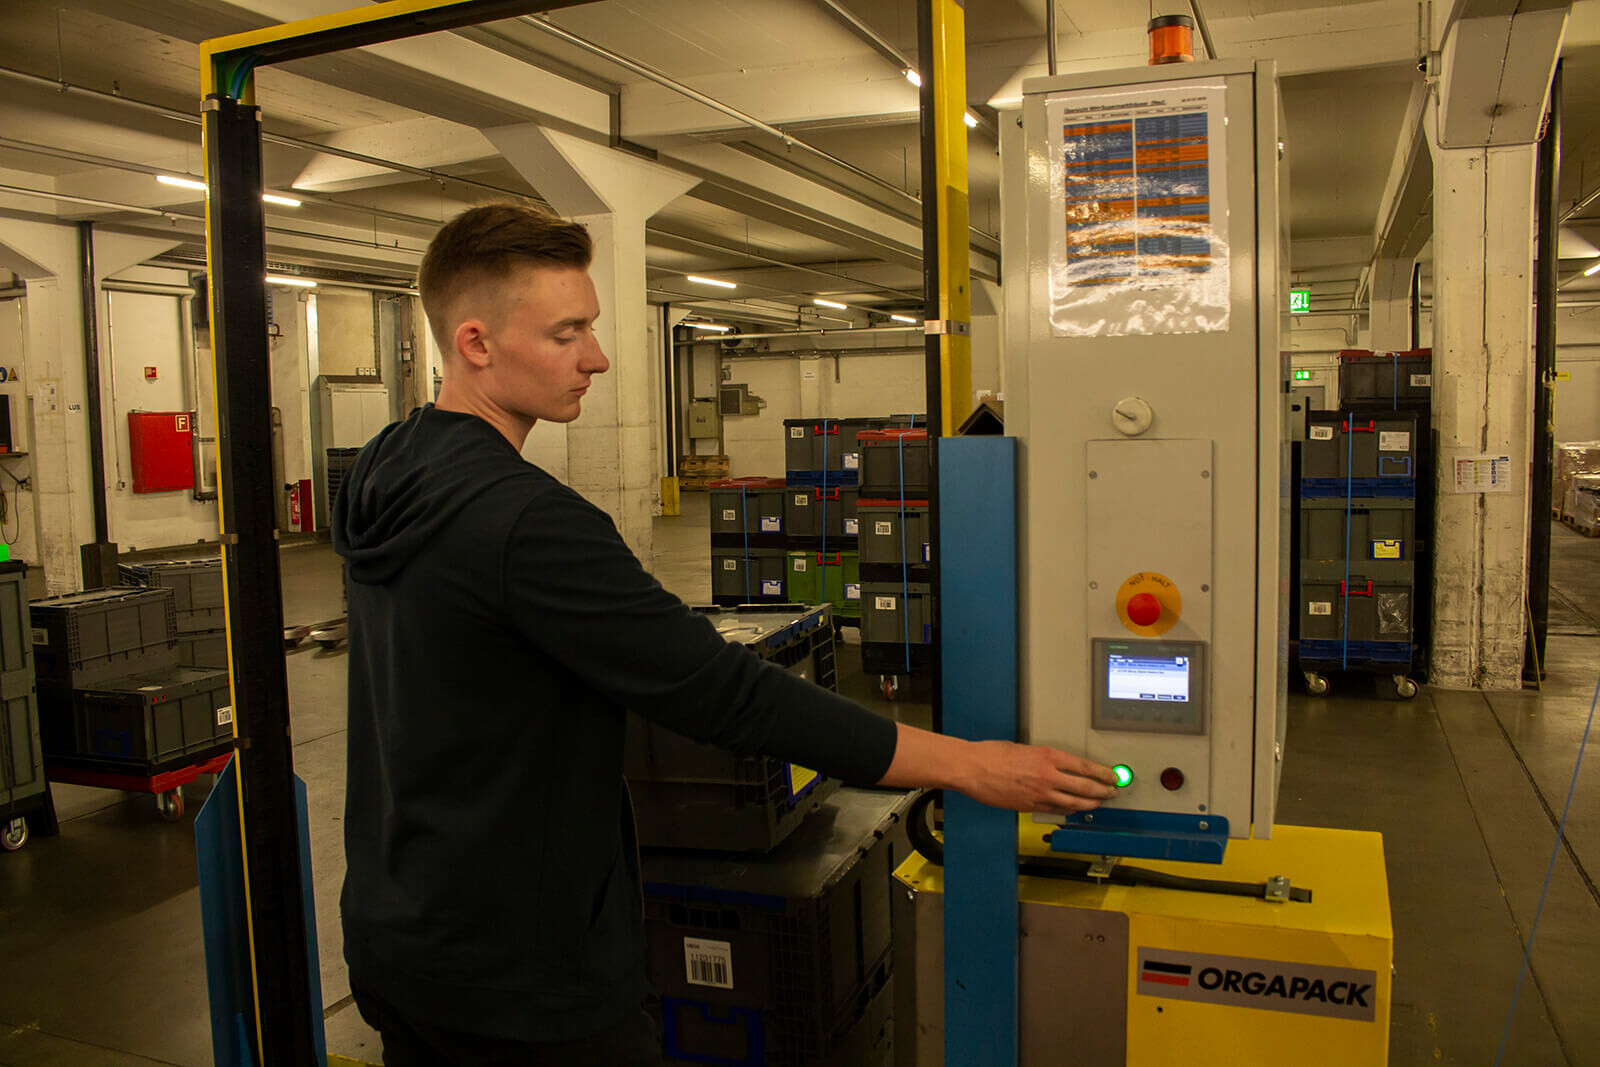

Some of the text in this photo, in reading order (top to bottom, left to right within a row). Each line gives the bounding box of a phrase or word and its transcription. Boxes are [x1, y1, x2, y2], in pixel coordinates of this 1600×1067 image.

[178, 417, 186, 429] F
[1129, 572, 1170, 588] NOT HALT
[1197, 967, 1372, 1008] ORGAPACK
